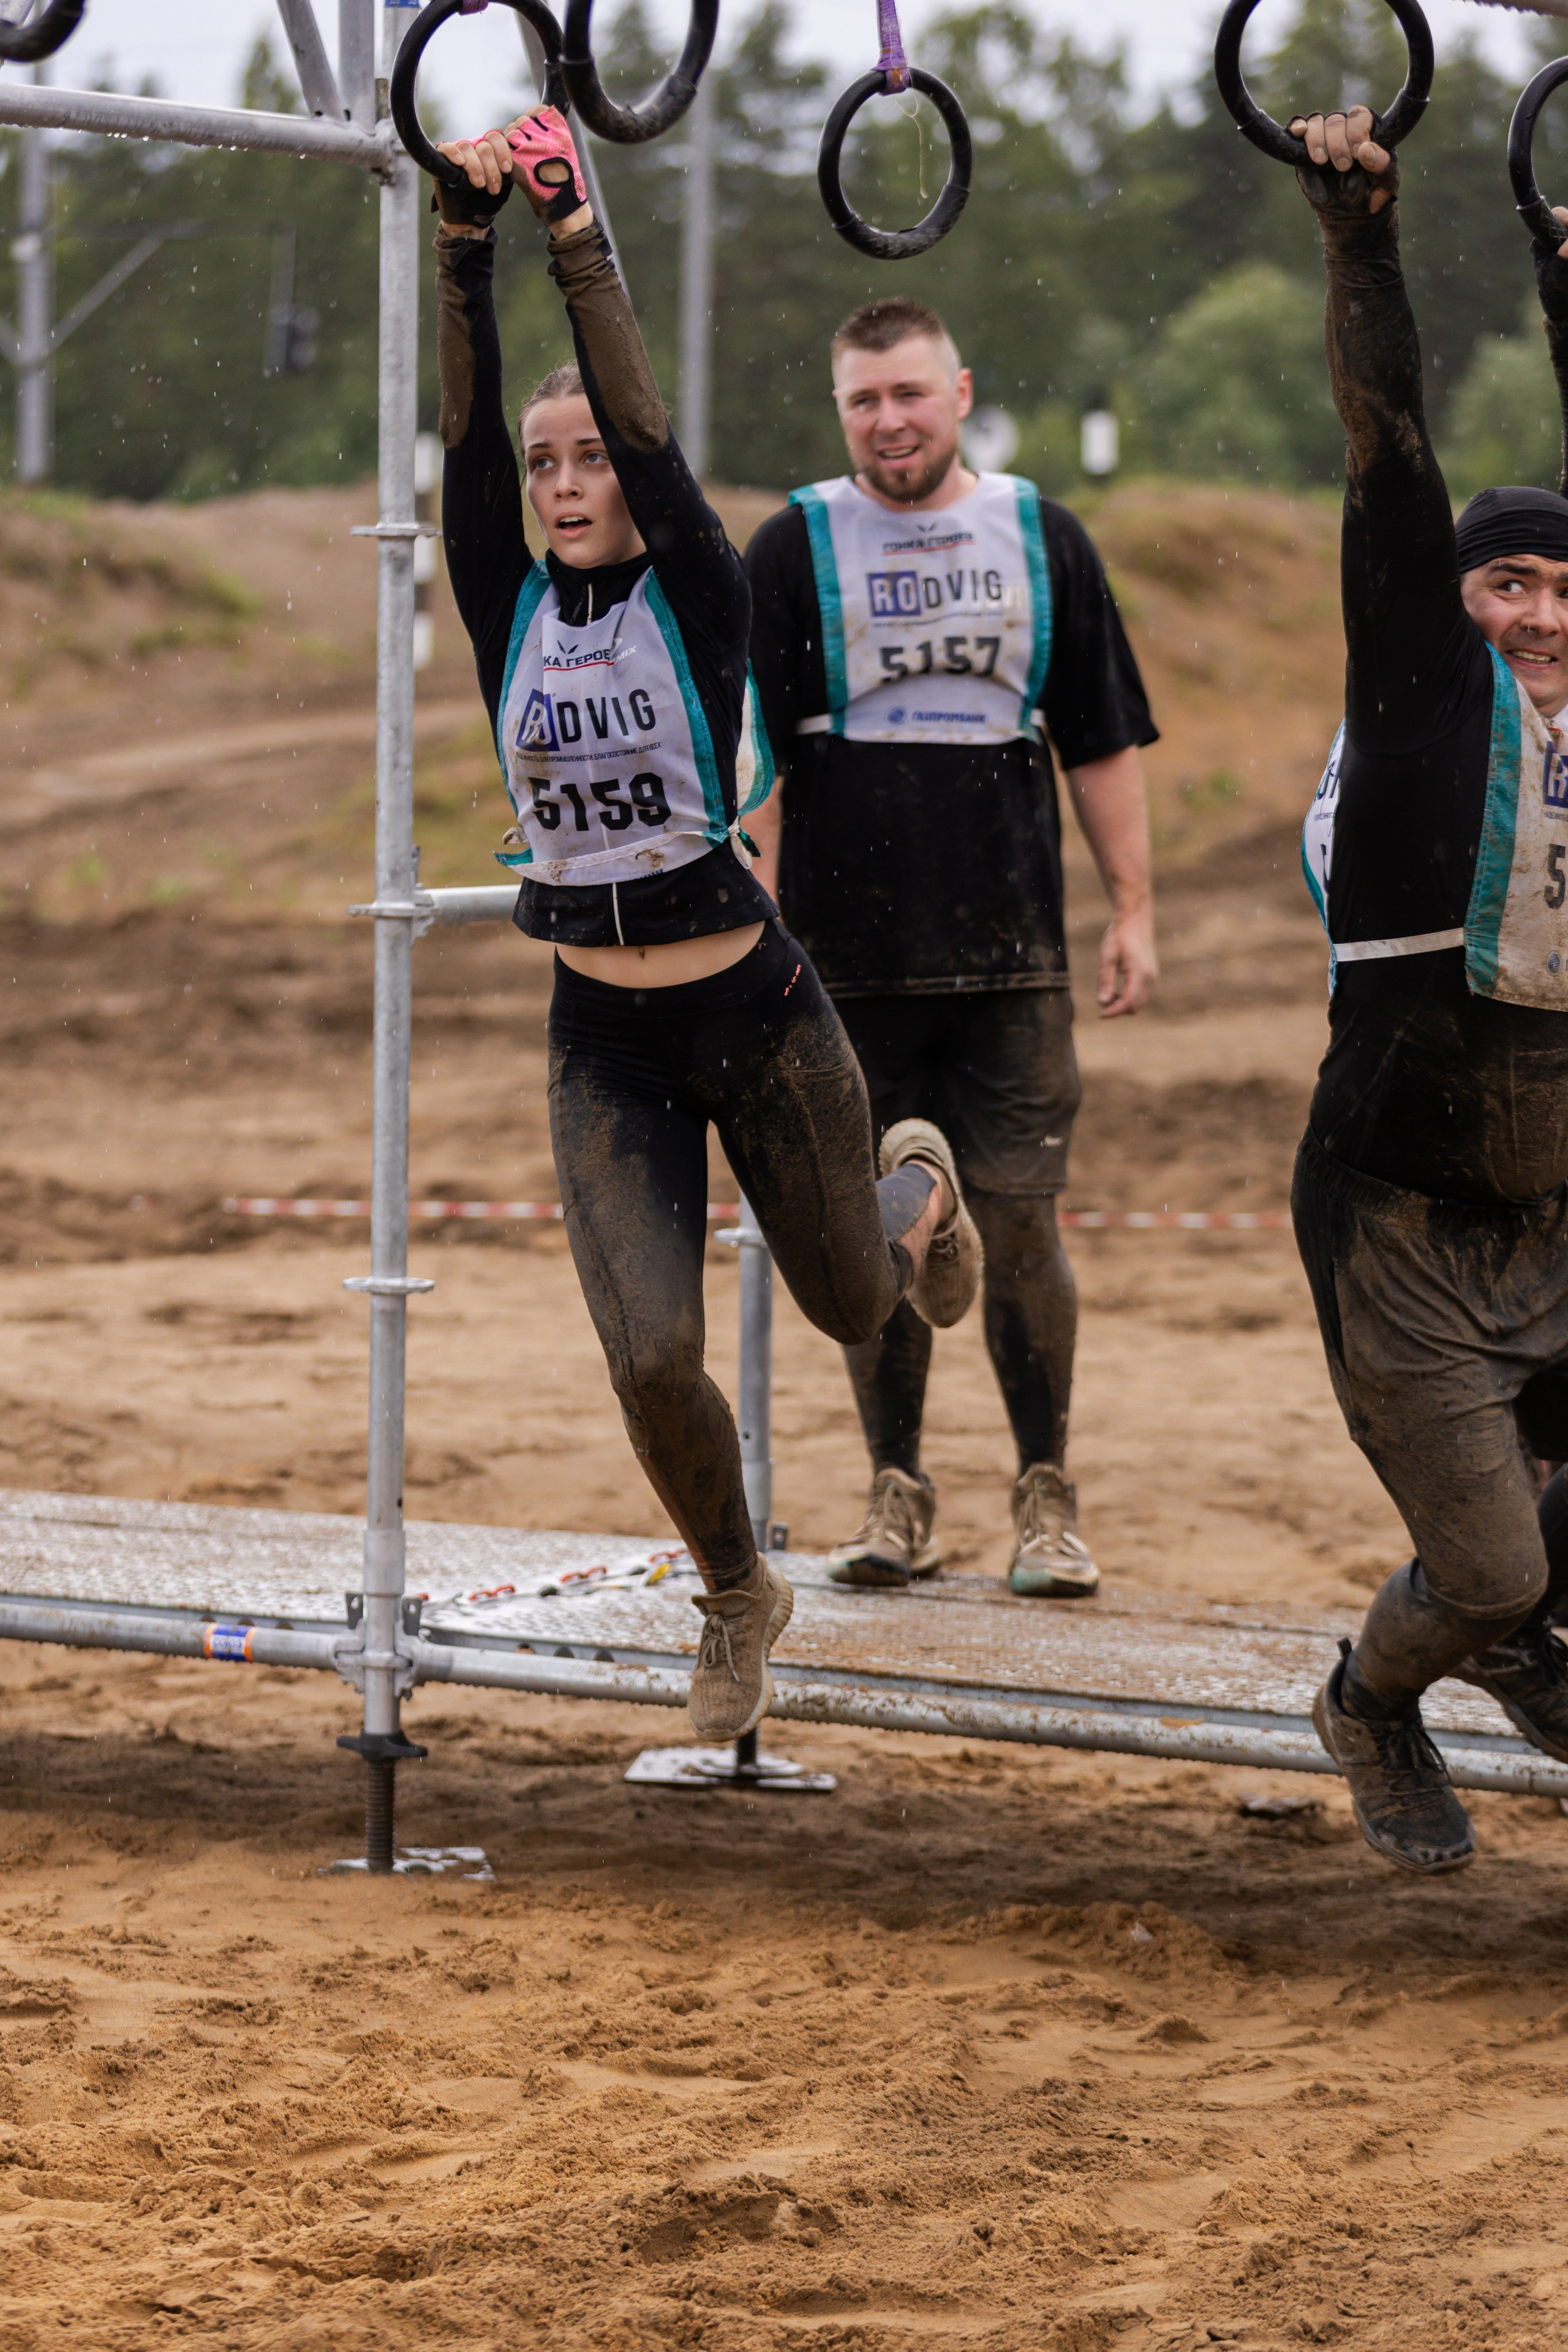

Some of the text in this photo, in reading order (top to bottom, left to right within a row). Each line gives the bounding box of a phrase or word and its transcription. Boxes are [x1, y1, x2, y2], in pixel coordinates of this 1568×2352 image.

[870, 569, 1003, 614] RODVIG
[880, 636, 1001, 682] 5157
[518, 688, 656, 746] RODVIG
[594, 747, 638, 760] БЛАГОСОСТОЯНИЕ
[638, 745, 649, 754] ДЛЯ
[649, 742, 662, 751] ВСЕХ
[528, 772, 671, 831] 5159
